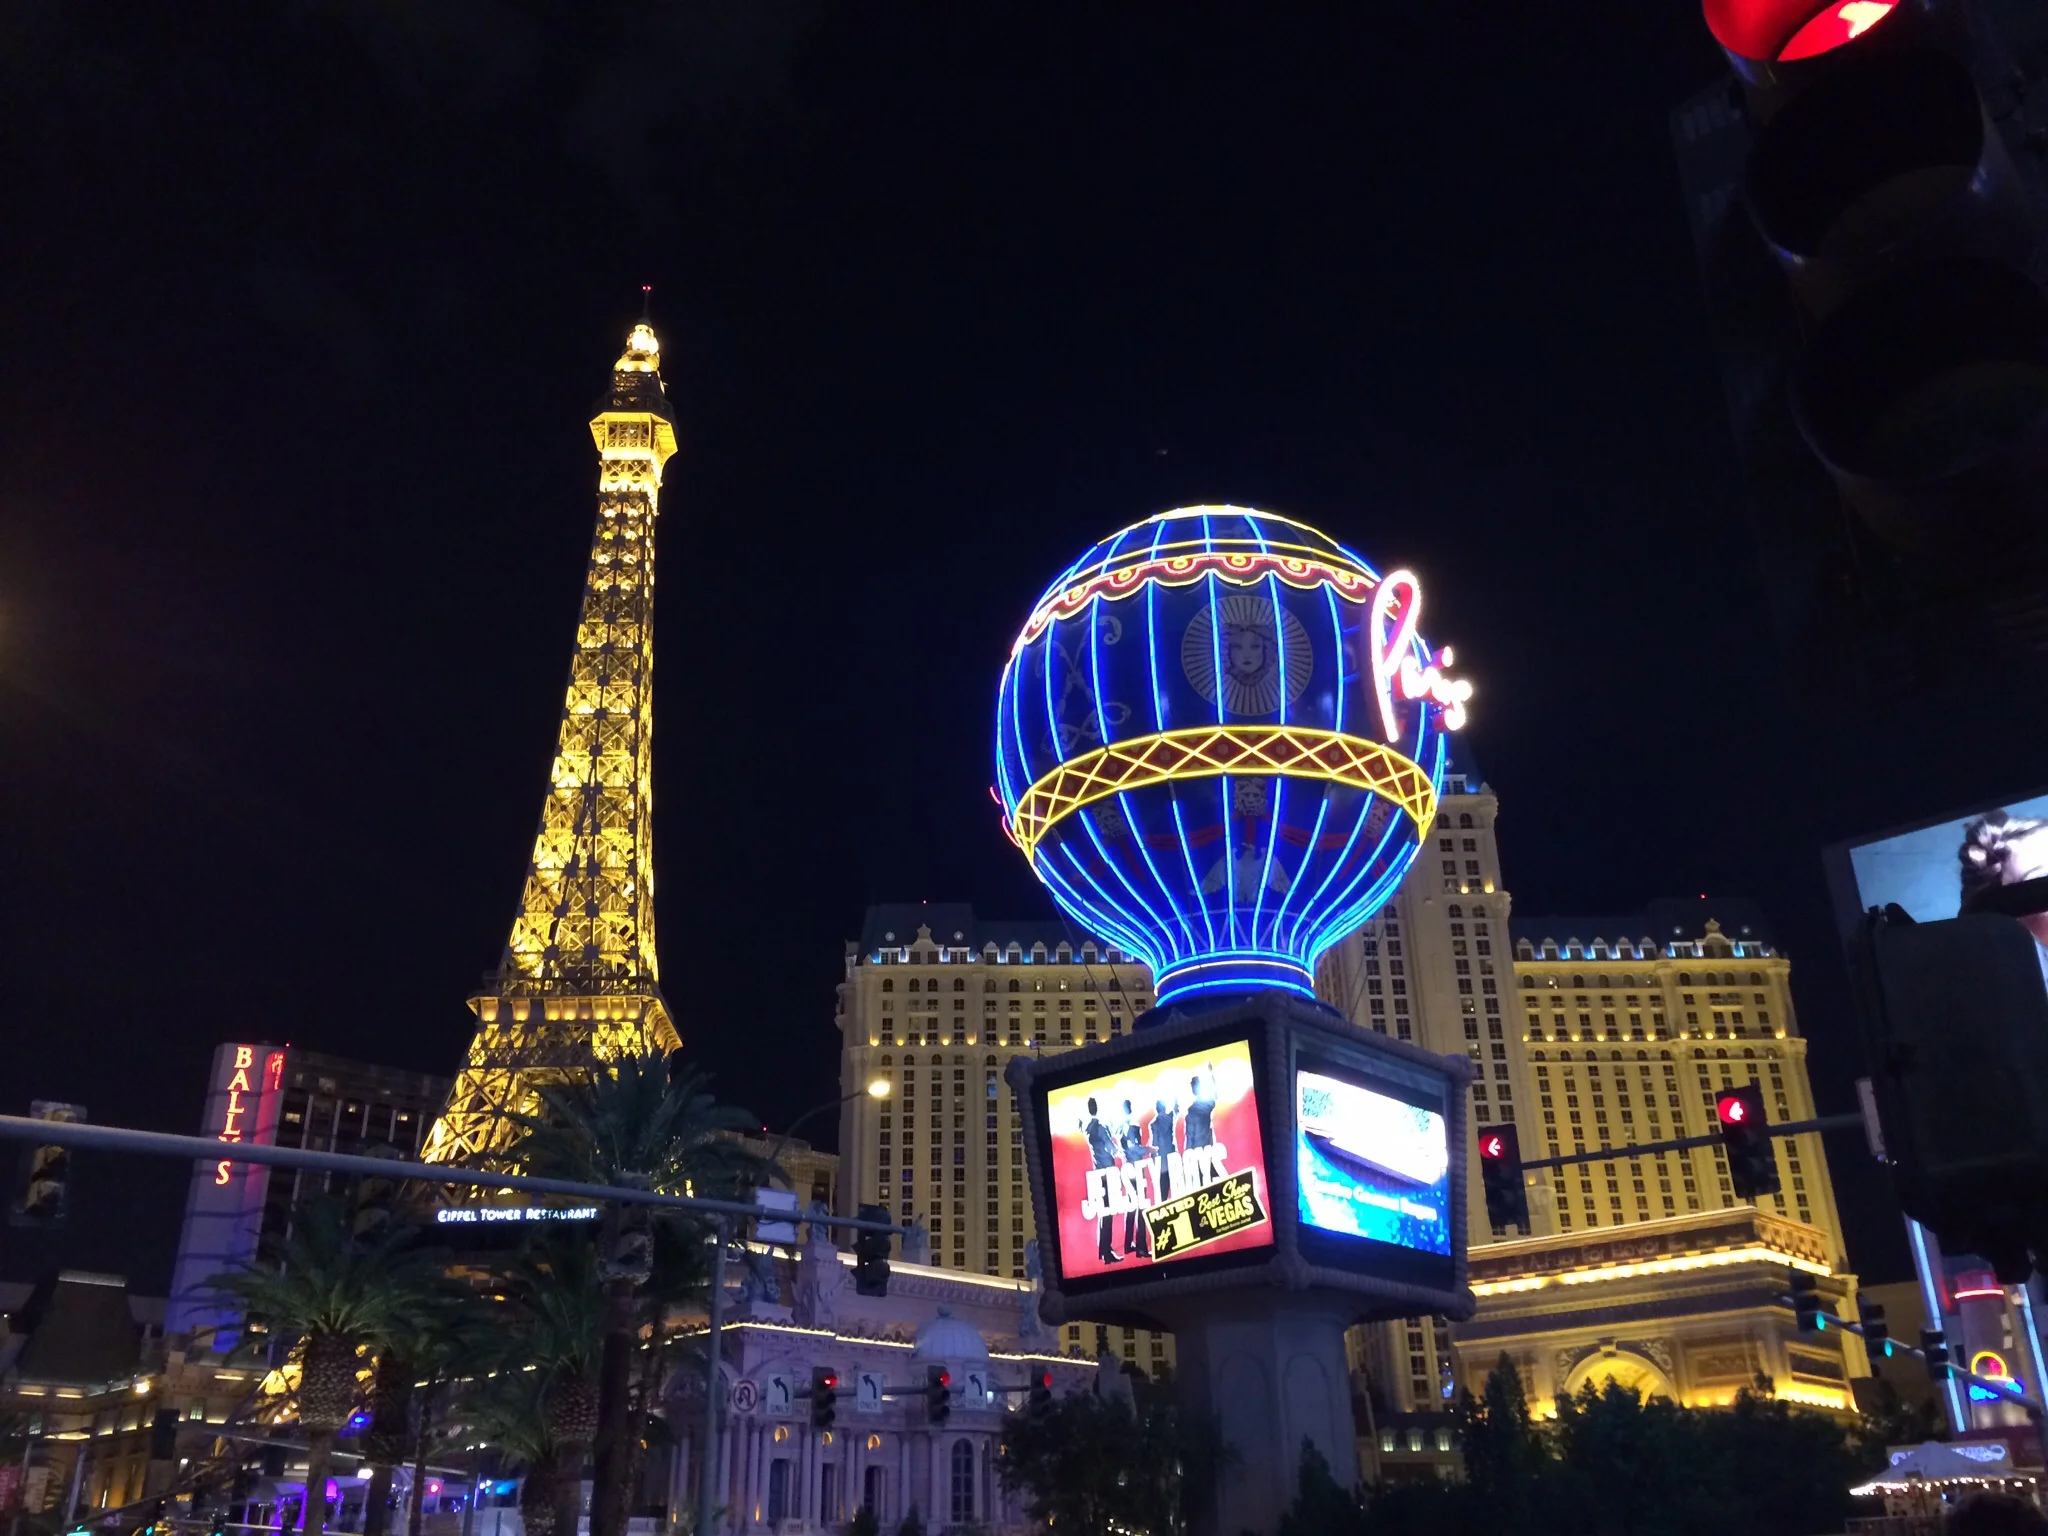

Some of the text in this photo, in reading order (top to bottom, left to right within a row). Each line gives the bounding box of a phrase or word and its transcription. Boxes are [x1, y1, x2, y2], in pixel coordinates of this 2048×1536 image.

[1081, 1142, 1229, 1220] JERSEY BOYS
[1197, 1178, 1252, 1215] Best Show
[437, 1207, 598, 1223] EIFFEL TOWER RESTAURANT
[1148, 1196, 1196, 1224] RATED
[1206, 1195, 1255, 1230] VEGAS
[1156, 1210, 1201, 1251] #1
[770, 1404, 790, 1414] ONLY
